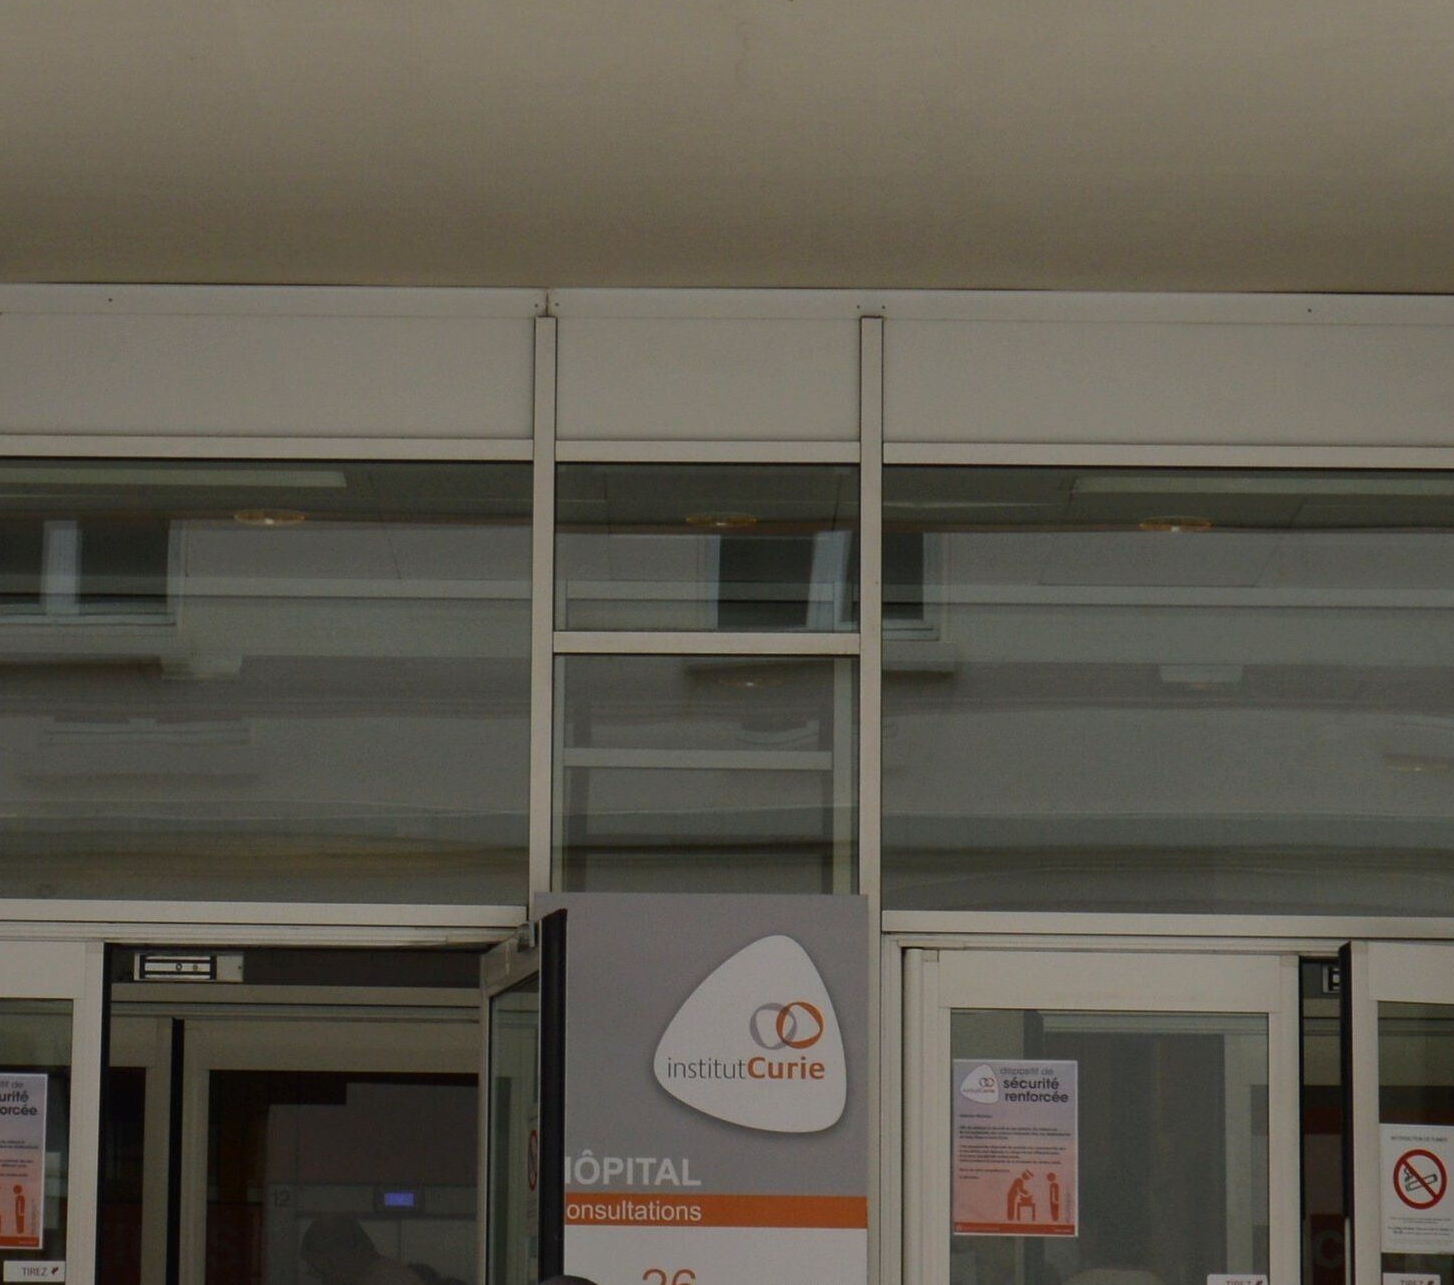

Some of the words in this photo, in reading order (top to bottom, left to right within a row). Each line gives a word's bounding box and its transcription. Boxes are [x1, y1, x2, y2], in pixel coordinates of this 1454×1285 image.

[1003, 1077, 1060, 1090] sécurité
[1005, 1090, 1069, 1103] renforcée
[565, 1149, 702, 1186] ÔPITAL
[566, 1200, 702, 1221] onsultations
